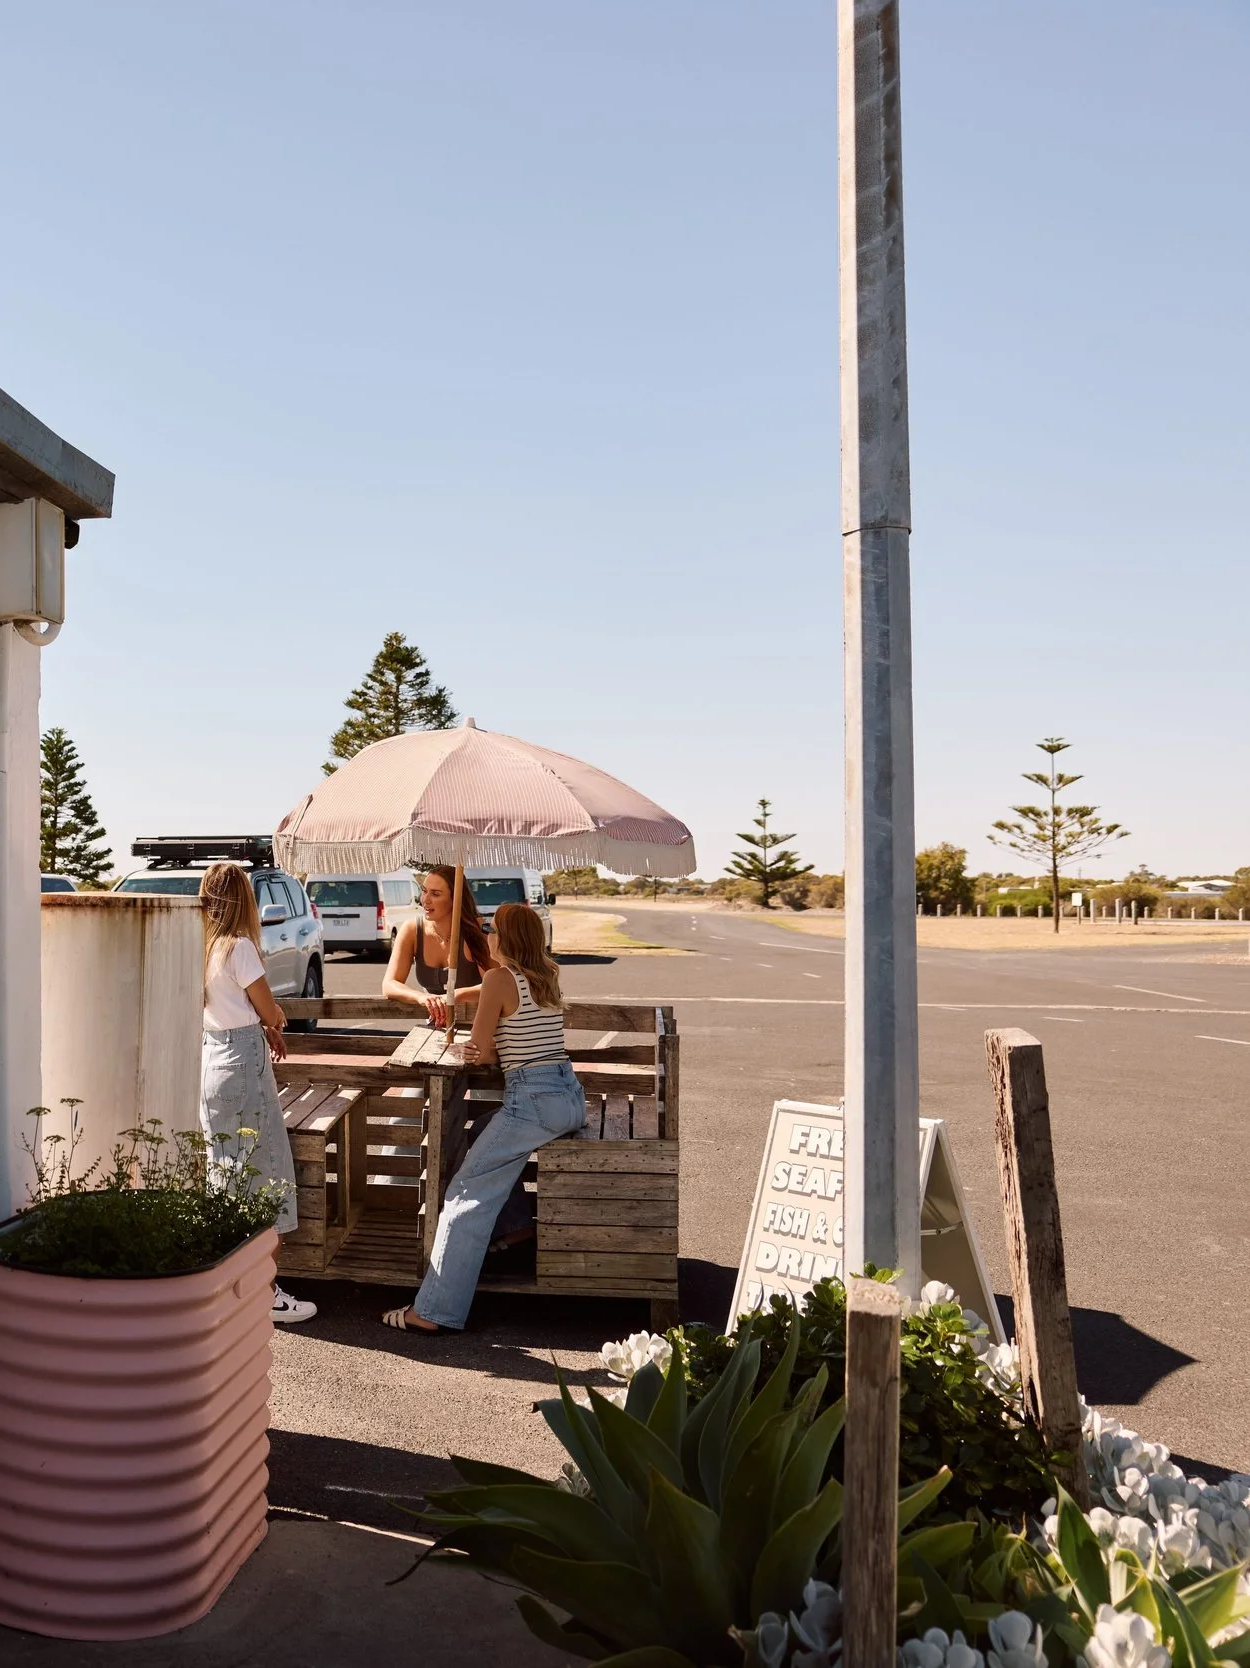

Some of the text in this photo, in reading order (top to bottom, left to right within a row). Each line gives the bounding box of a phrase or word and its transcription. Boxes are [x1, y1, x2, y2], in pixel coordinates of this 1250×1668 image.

[763, 1202, 810, 1240] FISH
[812, 1211, 828, 1245] &
[755, 1240, 843, 1284] DRIN
